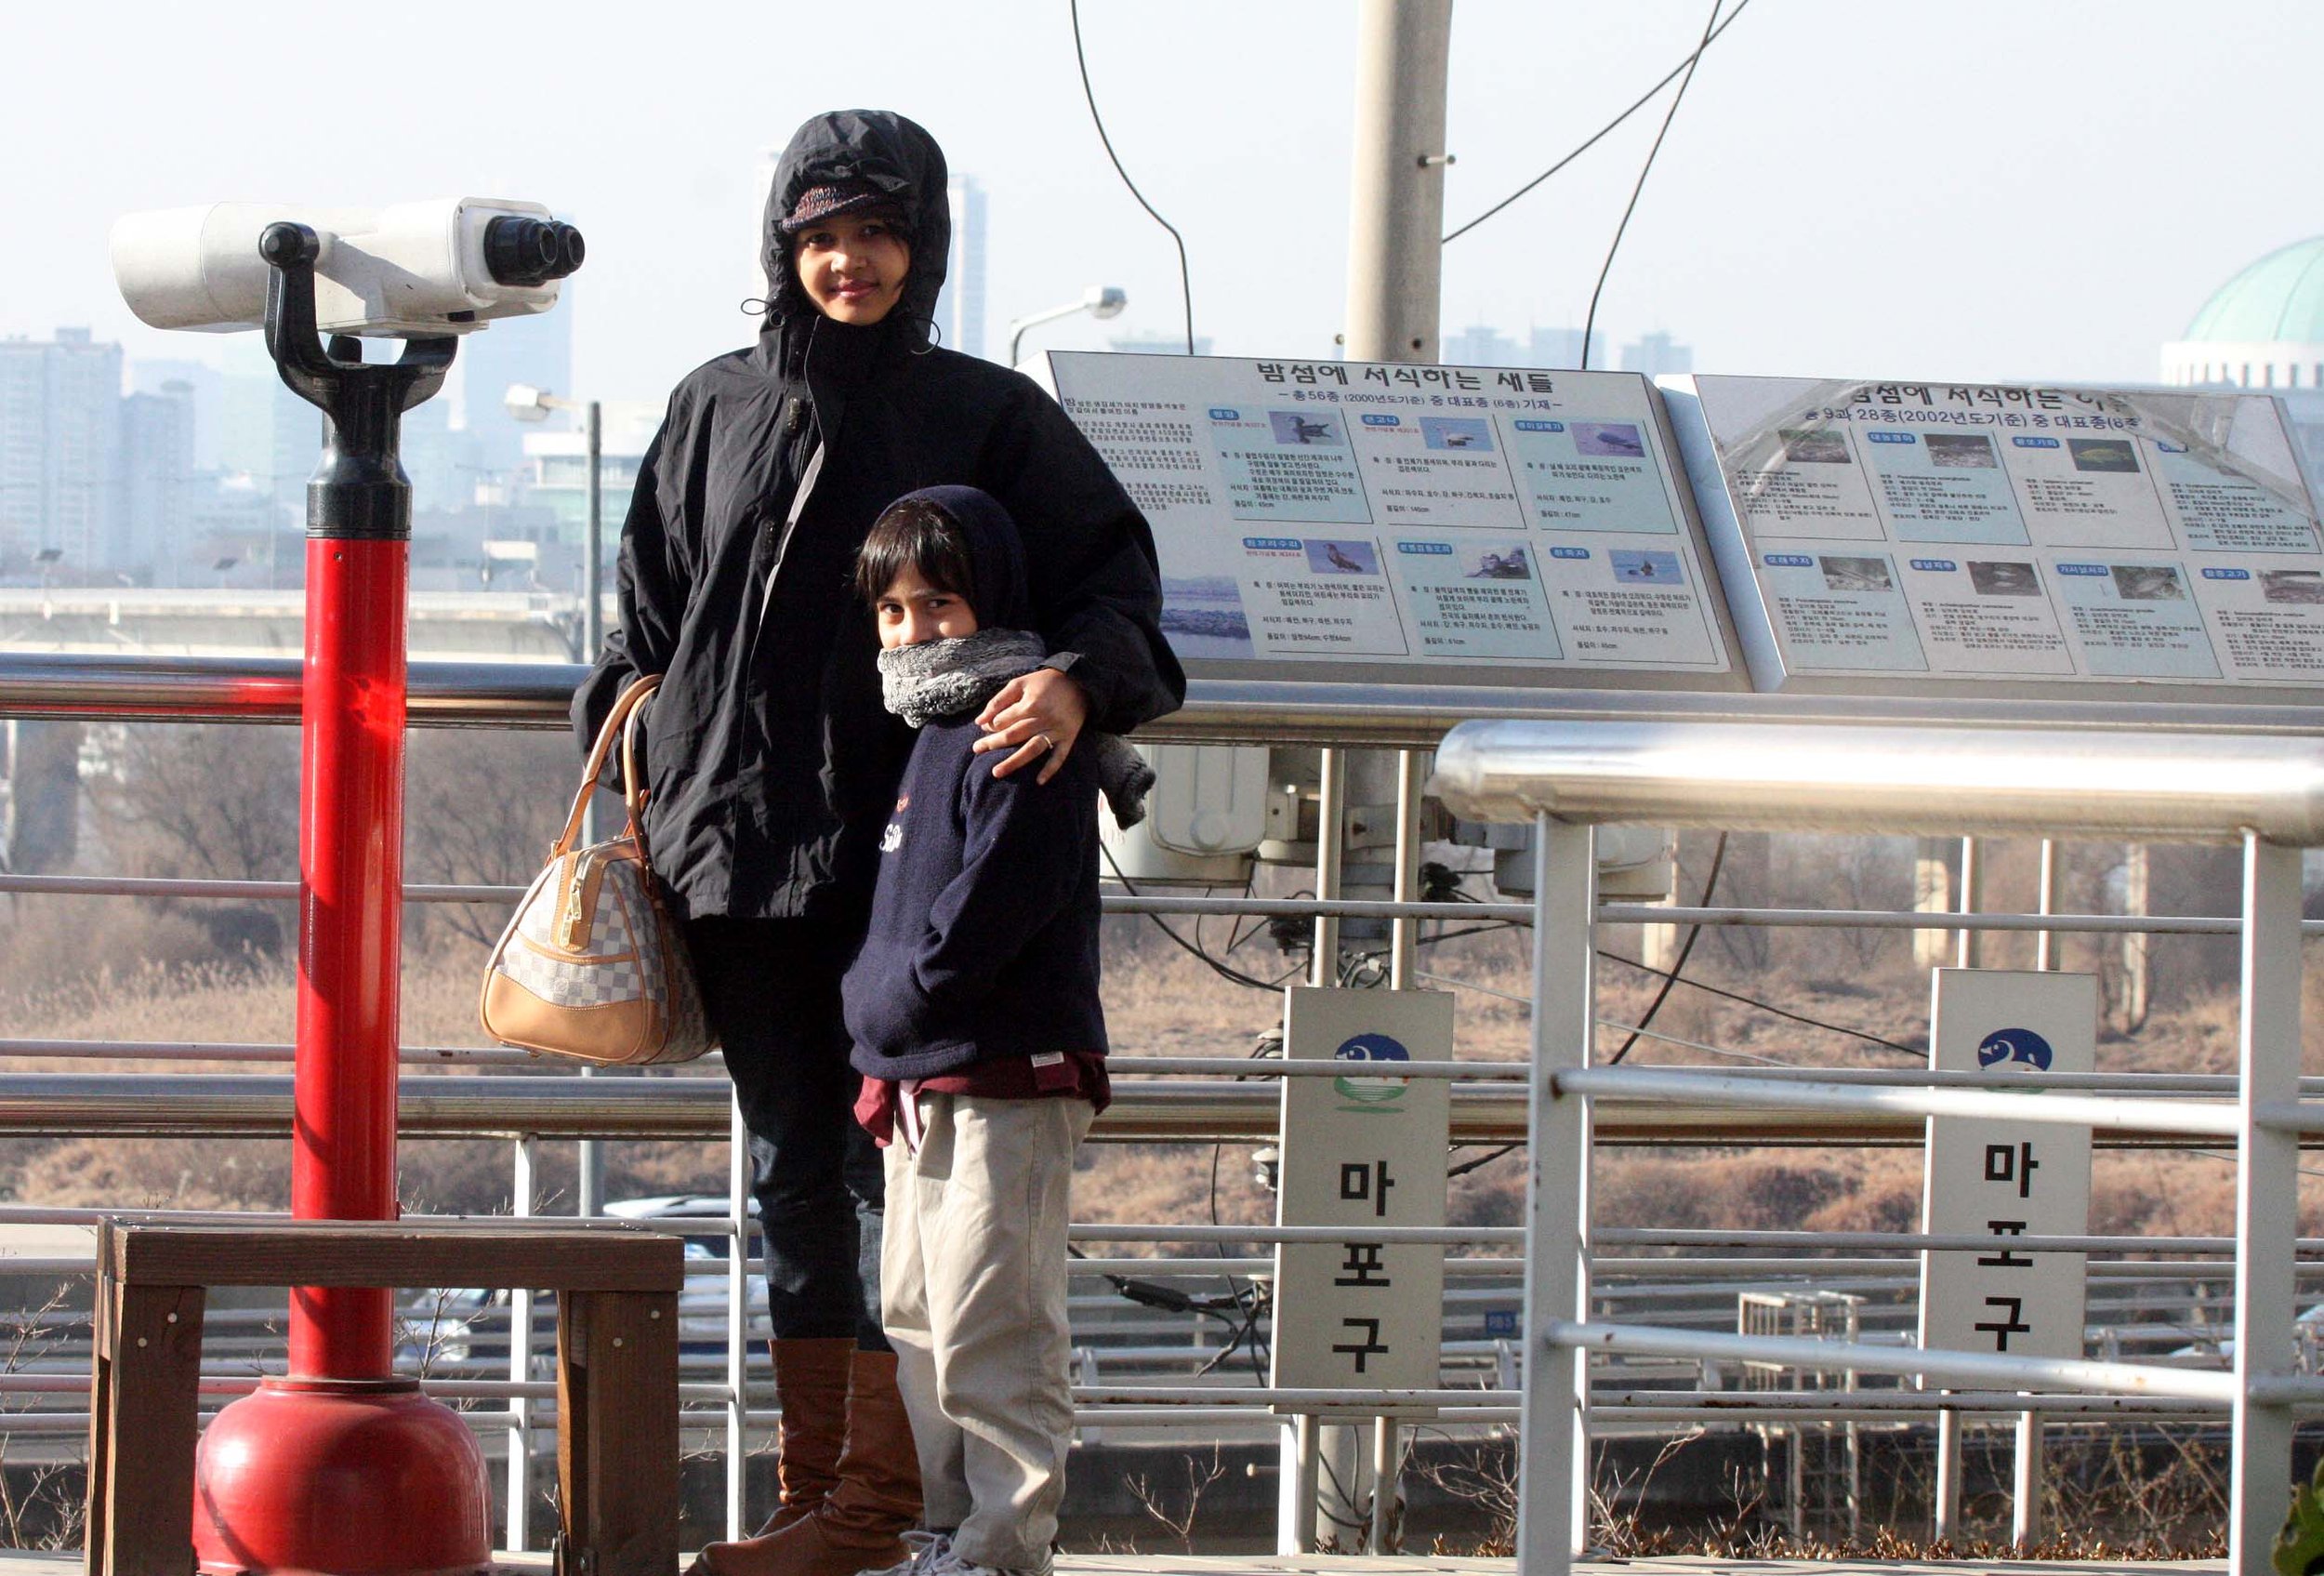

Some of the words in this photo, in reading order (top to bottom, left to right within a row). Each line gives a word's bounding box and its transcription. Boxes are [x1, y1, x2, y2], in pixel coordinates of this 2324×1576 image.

[1257, 363, 1349, 386] 밤섬에
[1364, 367, 1481, 391] 서식하는
[1498, 373, 1553, 393] 새들
[1948, 386, 2062, 410] 서식하는
[2032, 415, 2049, 428] 중
[1974, 1142, 2039, 1352] 마포구
[1332, 1159, 1395, 1373] 마포구
